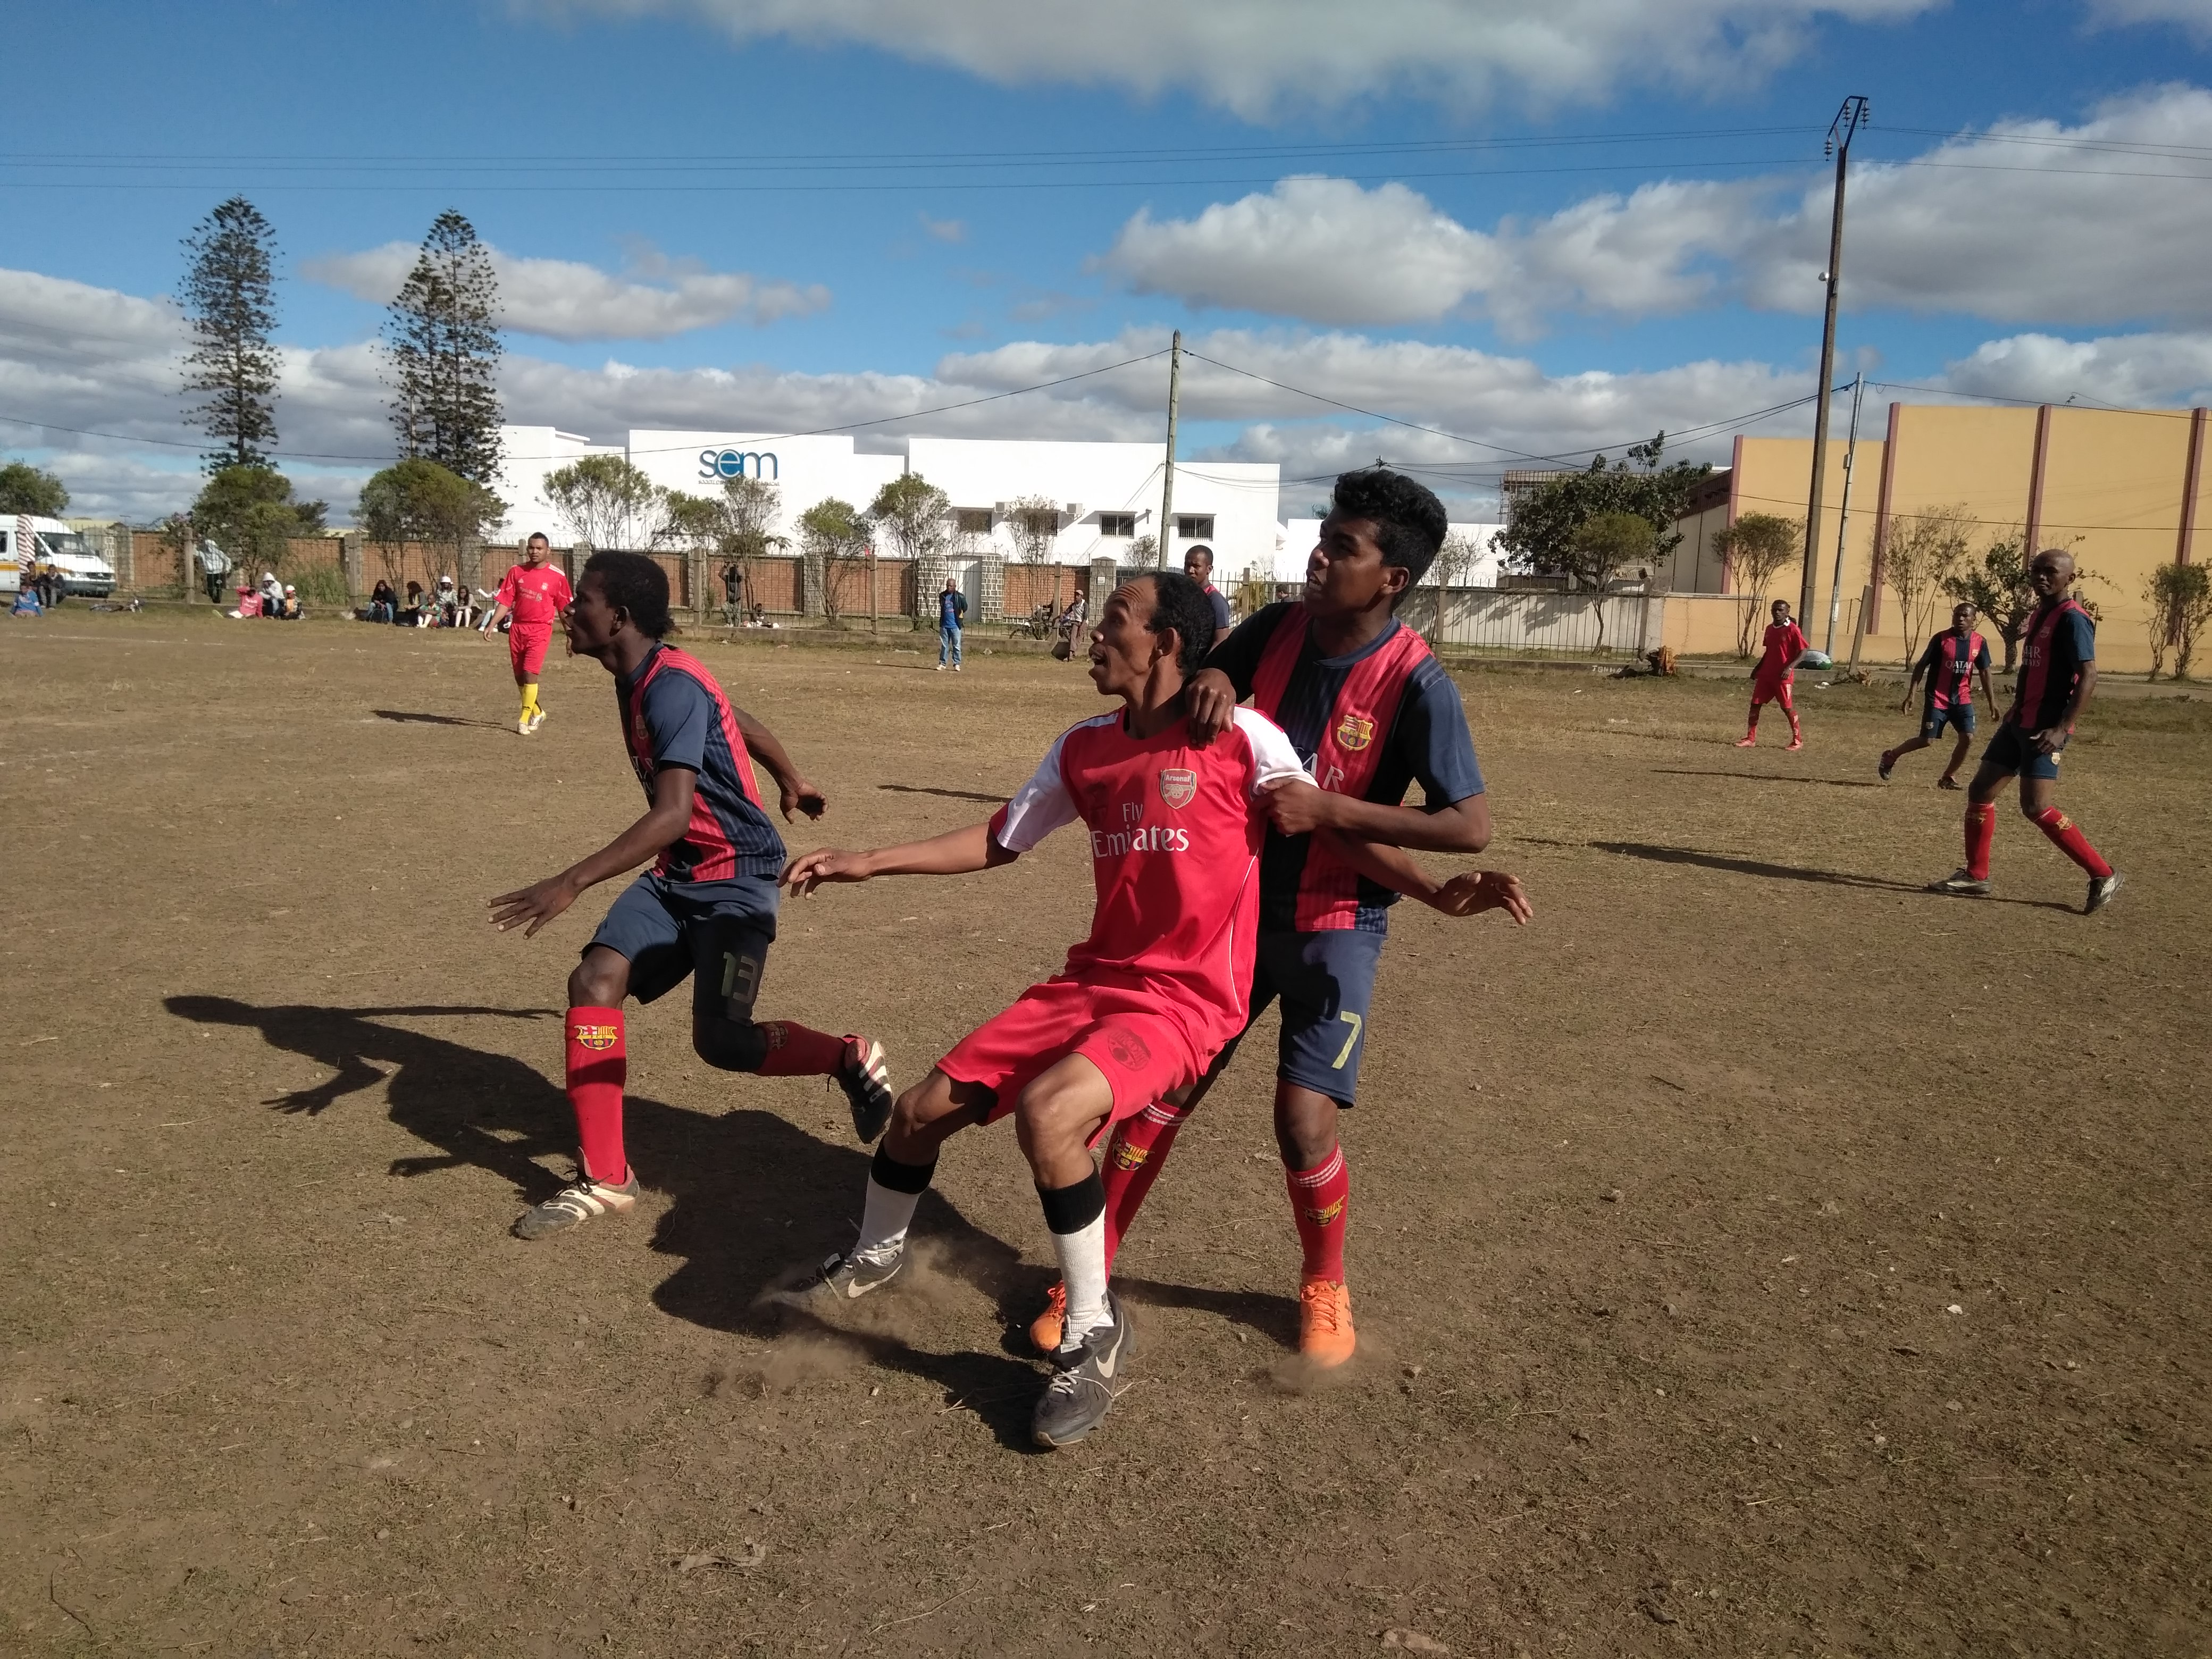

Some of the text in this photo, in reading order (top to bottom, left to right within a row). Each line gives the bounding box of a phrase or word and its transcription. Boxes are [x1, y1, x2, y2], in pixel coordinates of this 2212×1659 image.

[698, 449, 777, 480] sem
[1122, 802, 1143, 823] Fly
[1091, 824, 1189, 858] Emirates
[721, 951, 759, 1004] 13
[1331, 1011, 1362, 1069] 7
